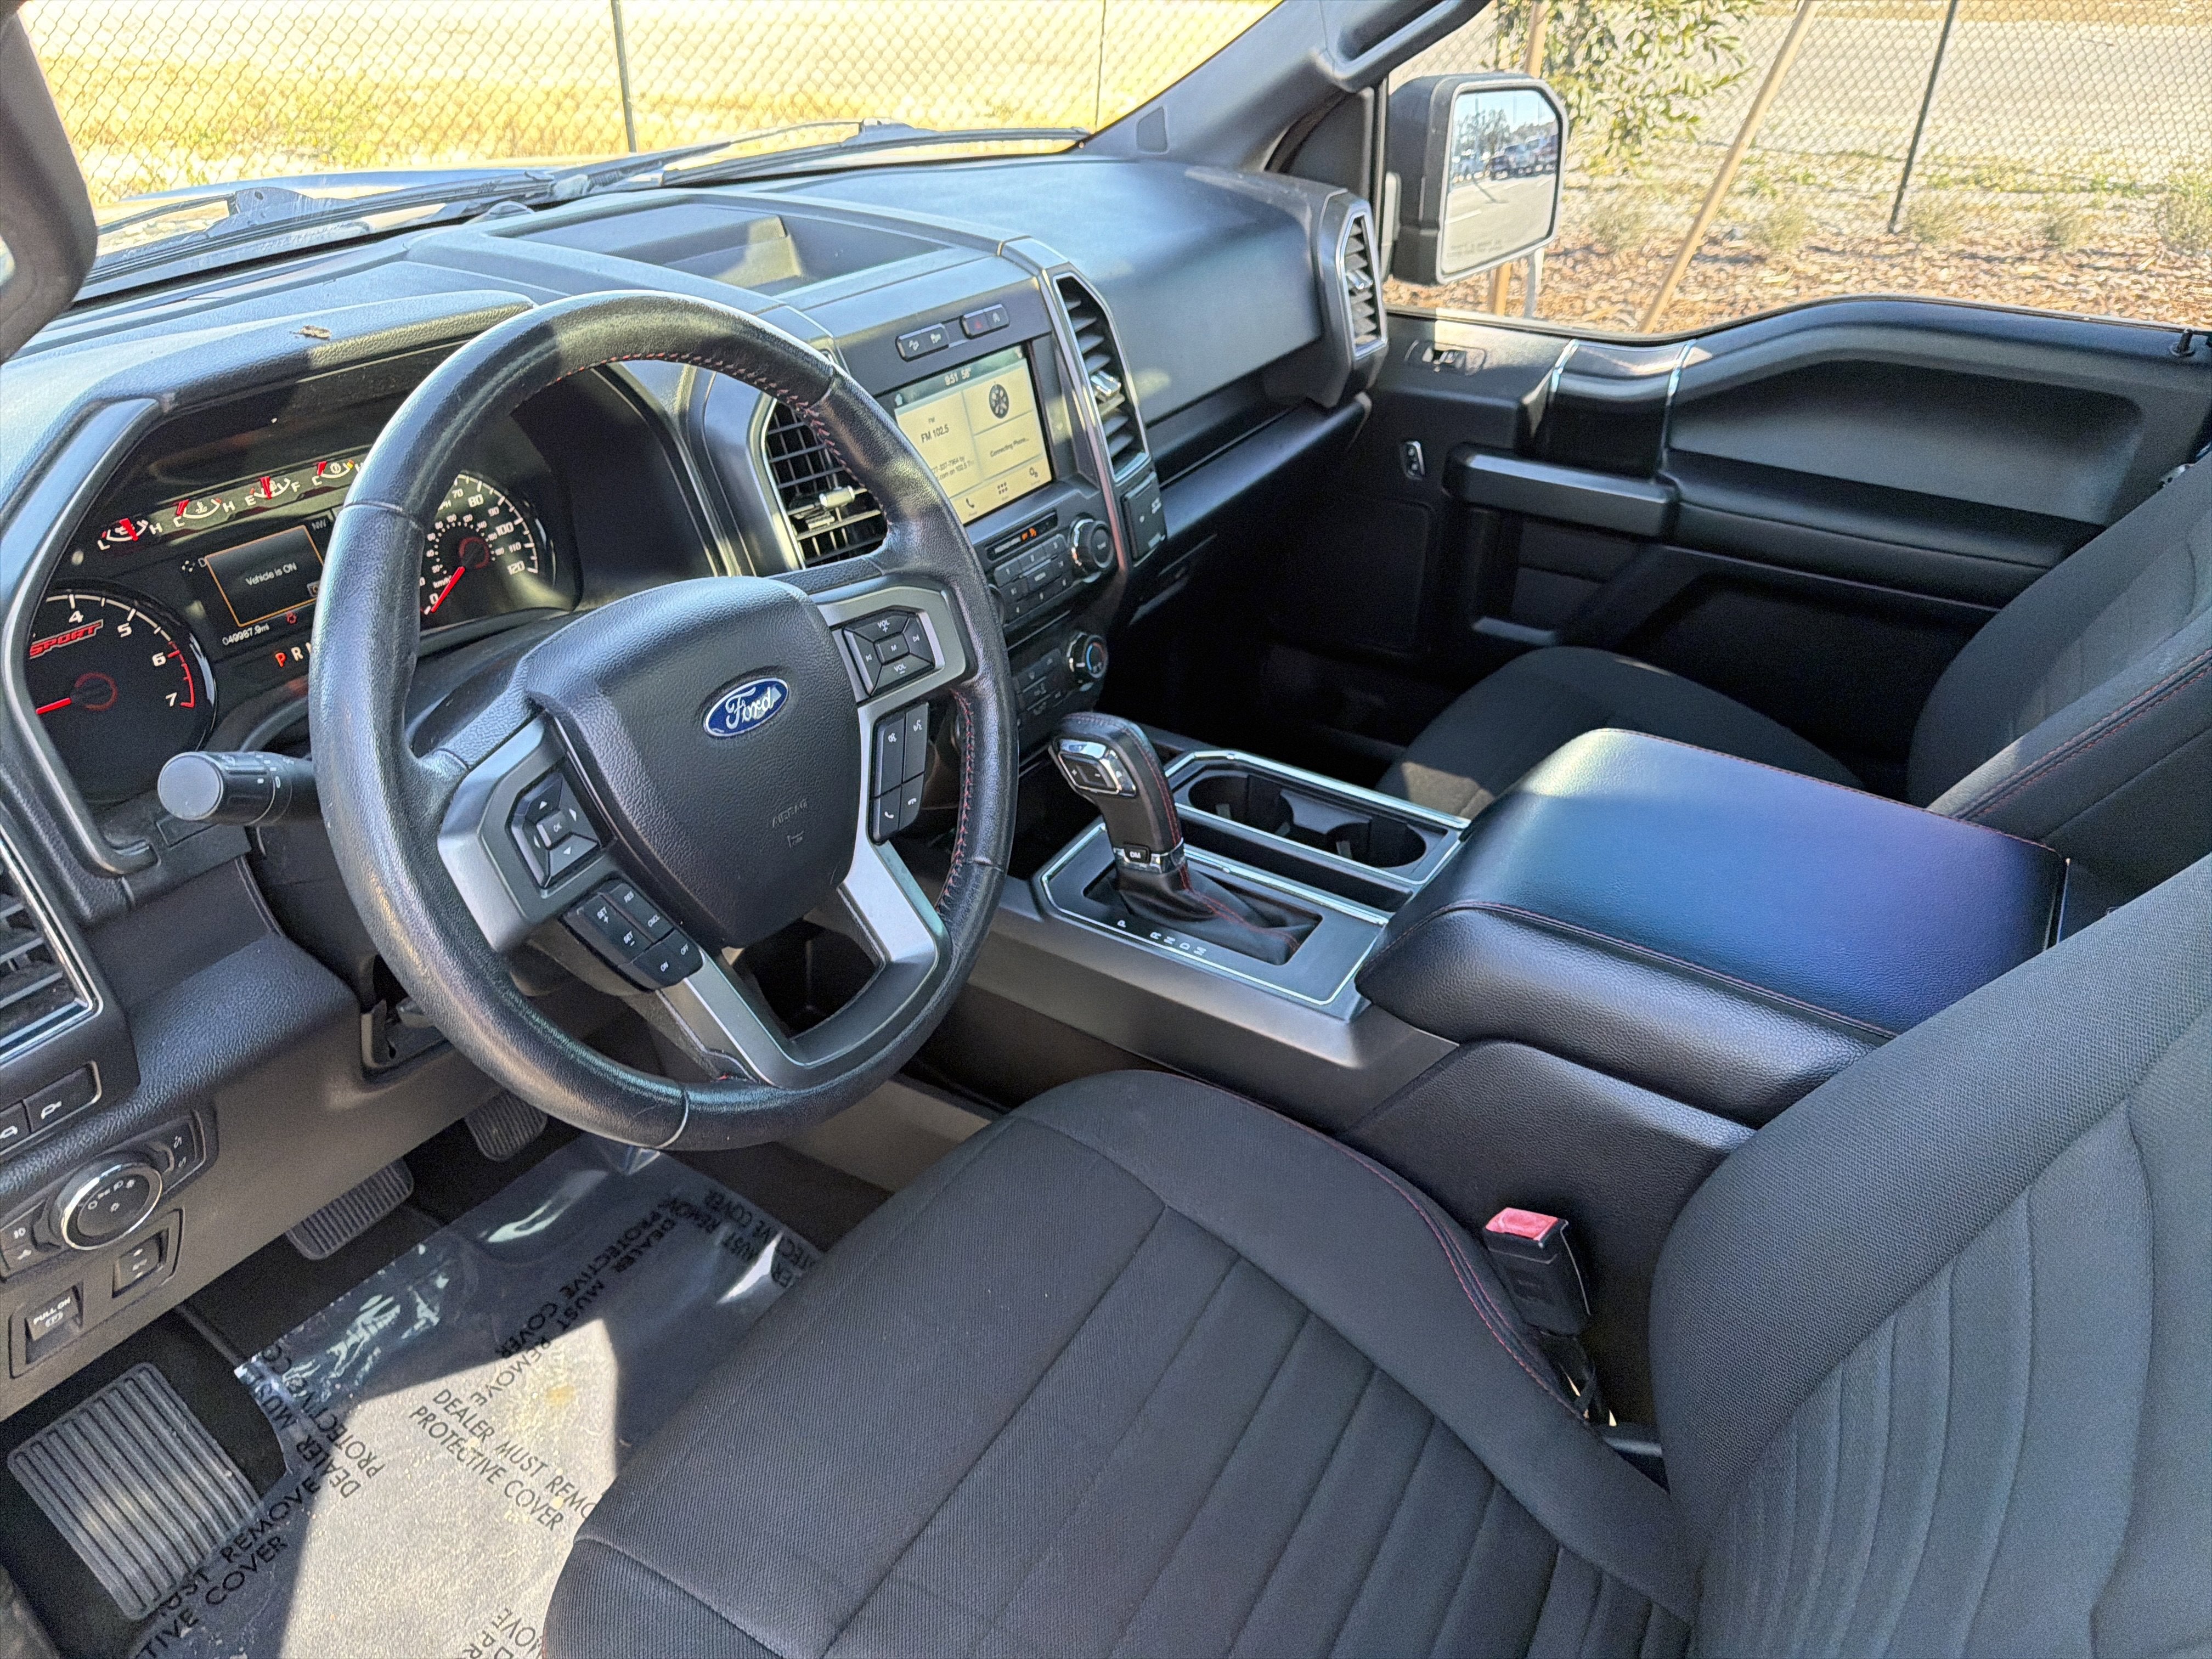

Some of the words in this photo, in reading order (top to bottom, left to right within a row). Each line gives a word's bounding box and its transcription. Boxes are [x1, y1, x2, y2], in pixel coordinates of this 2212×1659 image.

[921, 431, 933, 443] FM
[933, 424, 950, 438] 102.5
[990, 442, 1014, 458] Connecting
[291, 482, 301, 493] F
[452, 488, 464, 498] 70
[223, 501, 235, 513] H
[245, 497, 256, 506] E
[468, 494, 484, 507] 80
[488, 506, 500, 517] 90
[173, 517, 185, 527] C
[496, 522, 514, 536] 100
[149, 524, 163, 535] H
[509, 541, 522, 552] 110
[245, 571, 275, 586] Vehicle
[274, 568, 283, 577] is
[283, 562, 297, 573] ON
[507, 561, 525, 575] 120
[69, 611, 84, 623] 4
[877, 619, 890, 629] VOL
[117, 622, 132, 638] 5
[29, 622, 102, 657] SPORT
[152, 652, 167, 667] 6
[275, 652, 287, 668] P
[291, 646, 303, 661] R
[894, 663, 907, 672] VOL
[165, 692, 178, 707] 7
[725, 686, 775, 730] Ford
[553, 822, 562, 833] OK
[597, 906, 607, 919] SET
[623, 931, 634, 944] SET
[1117, 919, 1126, 928] P
[1150, 932, 1162, 940] R
[1164, 936, 1176, 945] N
[1179, 942, 1190, 951] D
[680, 943, 689, 956] OFF
[660, 961, 669, 972] ON
[33, 1307, 57, 1325] PULL
[57, 1296, 71, 1310] ON
[556, 1280, 605, 1331] MUST
[495, 1303, 558, 1359] COVER
[470, 1336, 552, 1407] REMOVE
[432, 1389, 495, 1443] DEALER
[494, 1440, 548, 1478] MUST
[296, 1434, 362, 1498] DEALER
[409, 1406, 506, 1485] PROTECTIVE
[504, 1480, 564, 1531] COVER
[161, 1567, 212, 1617] UST
[221, 1476, 321, 1564] REMOVE
[205, 1536, 289, 1605] COVER
